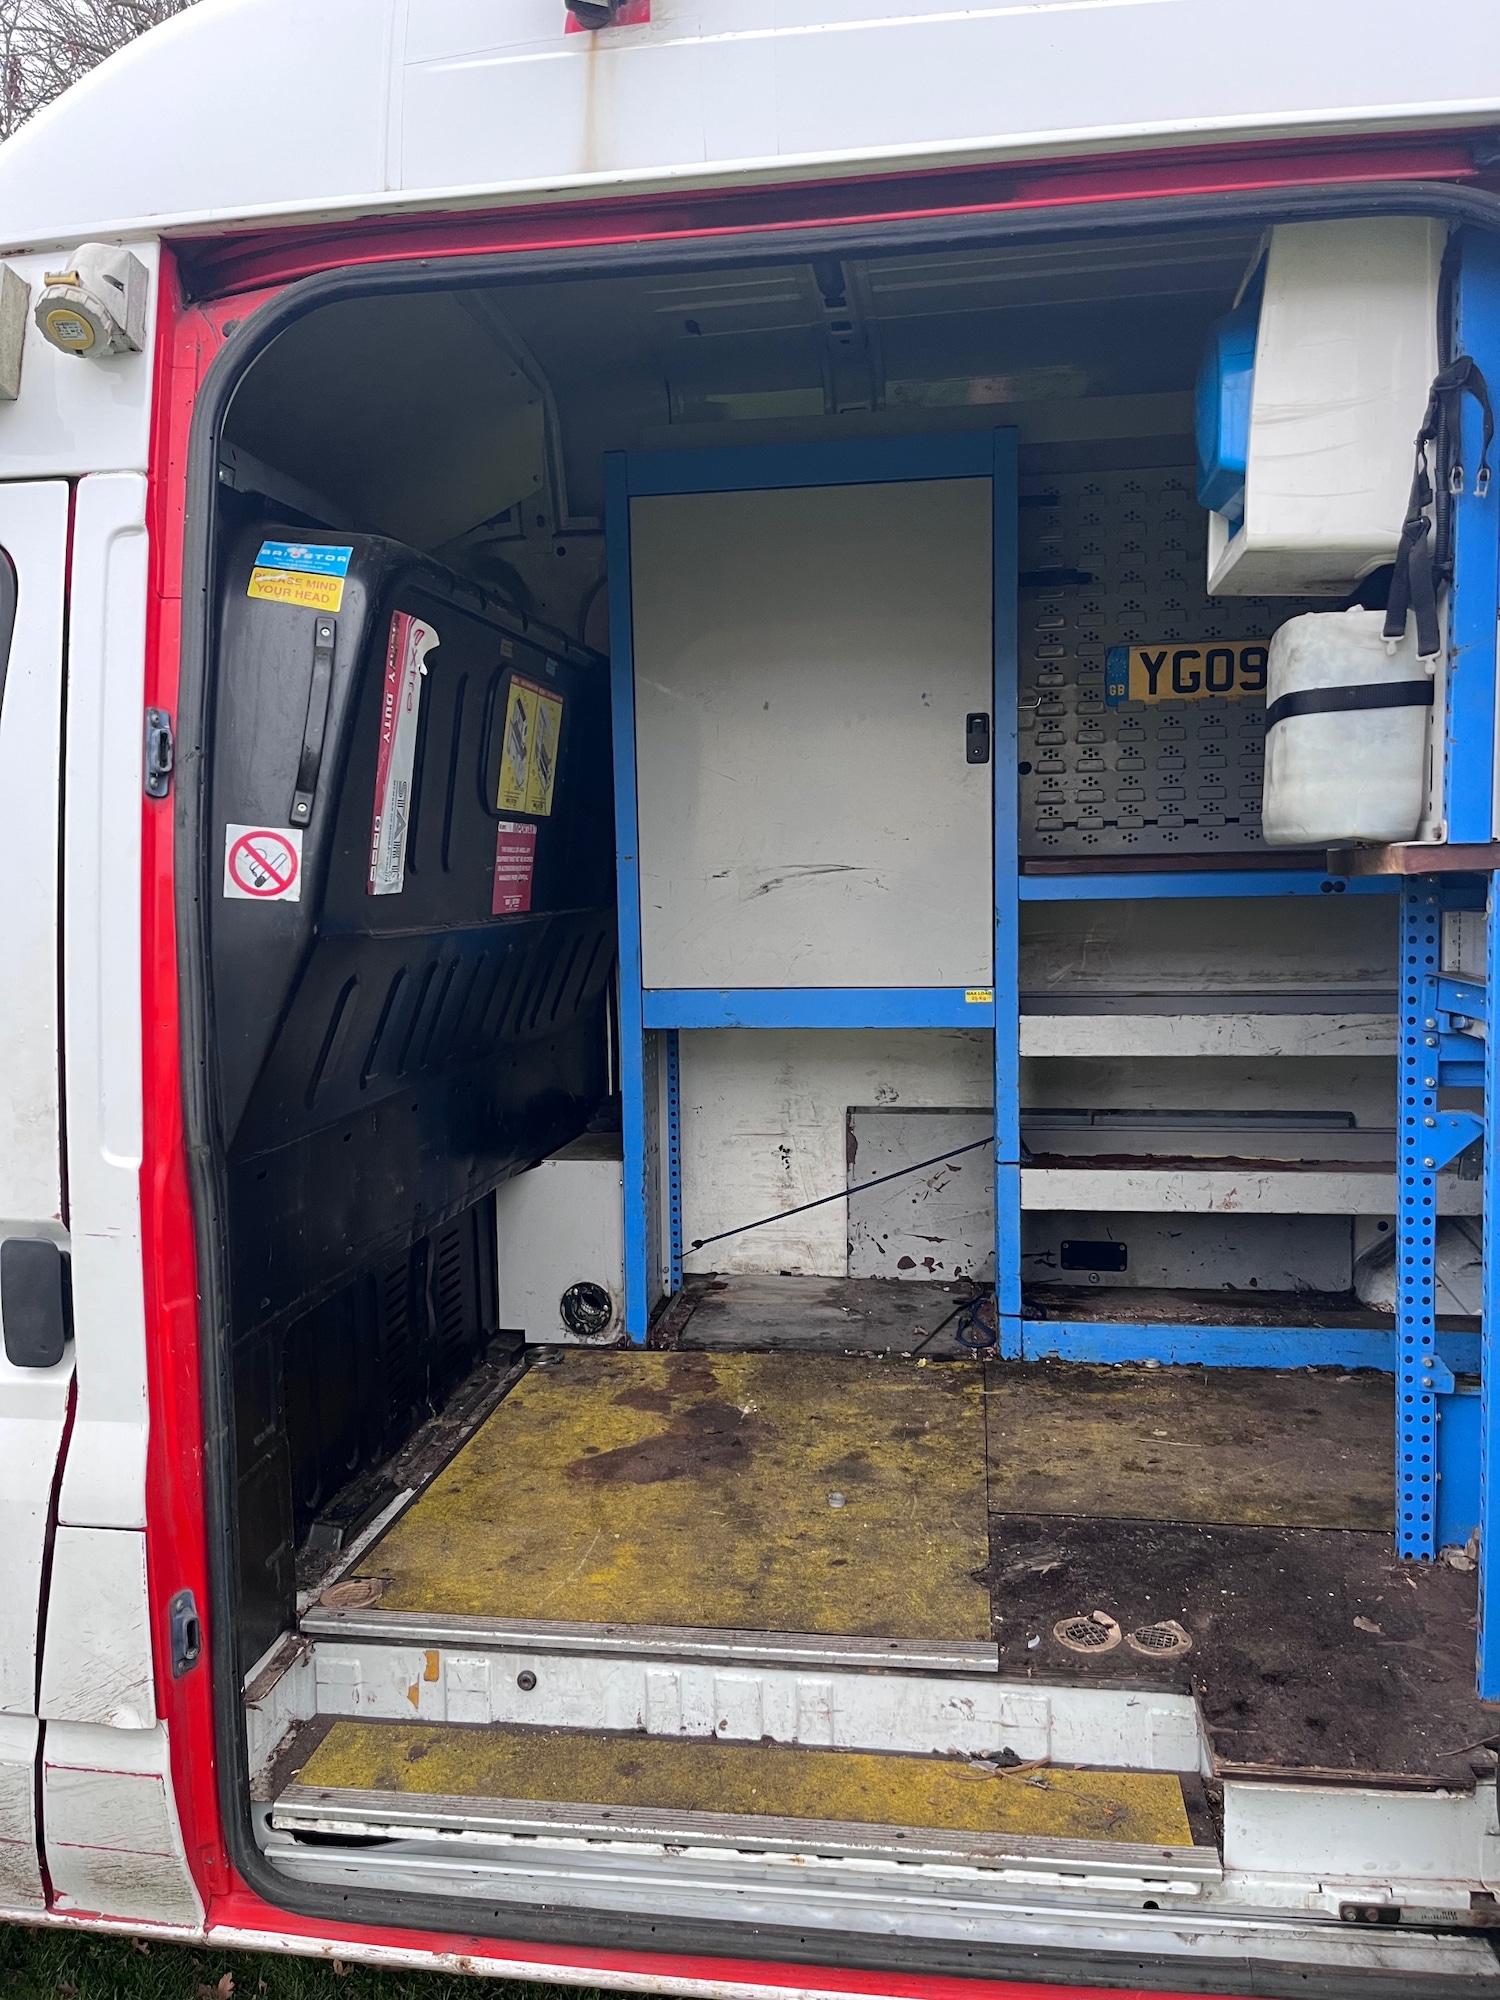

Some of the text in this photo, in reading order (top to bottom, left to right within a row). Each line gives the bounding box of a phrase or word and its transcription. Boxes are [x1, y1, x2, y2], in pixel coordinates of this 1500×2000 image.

[257, 584, 330, 604] YOUR HEAD
[306, 579, 337, 592] MIND
[1139, 646, 1268, 695] YG09
[1109, 684, 1125, 697] GB
[383, 693, 394, 743] DUTY
